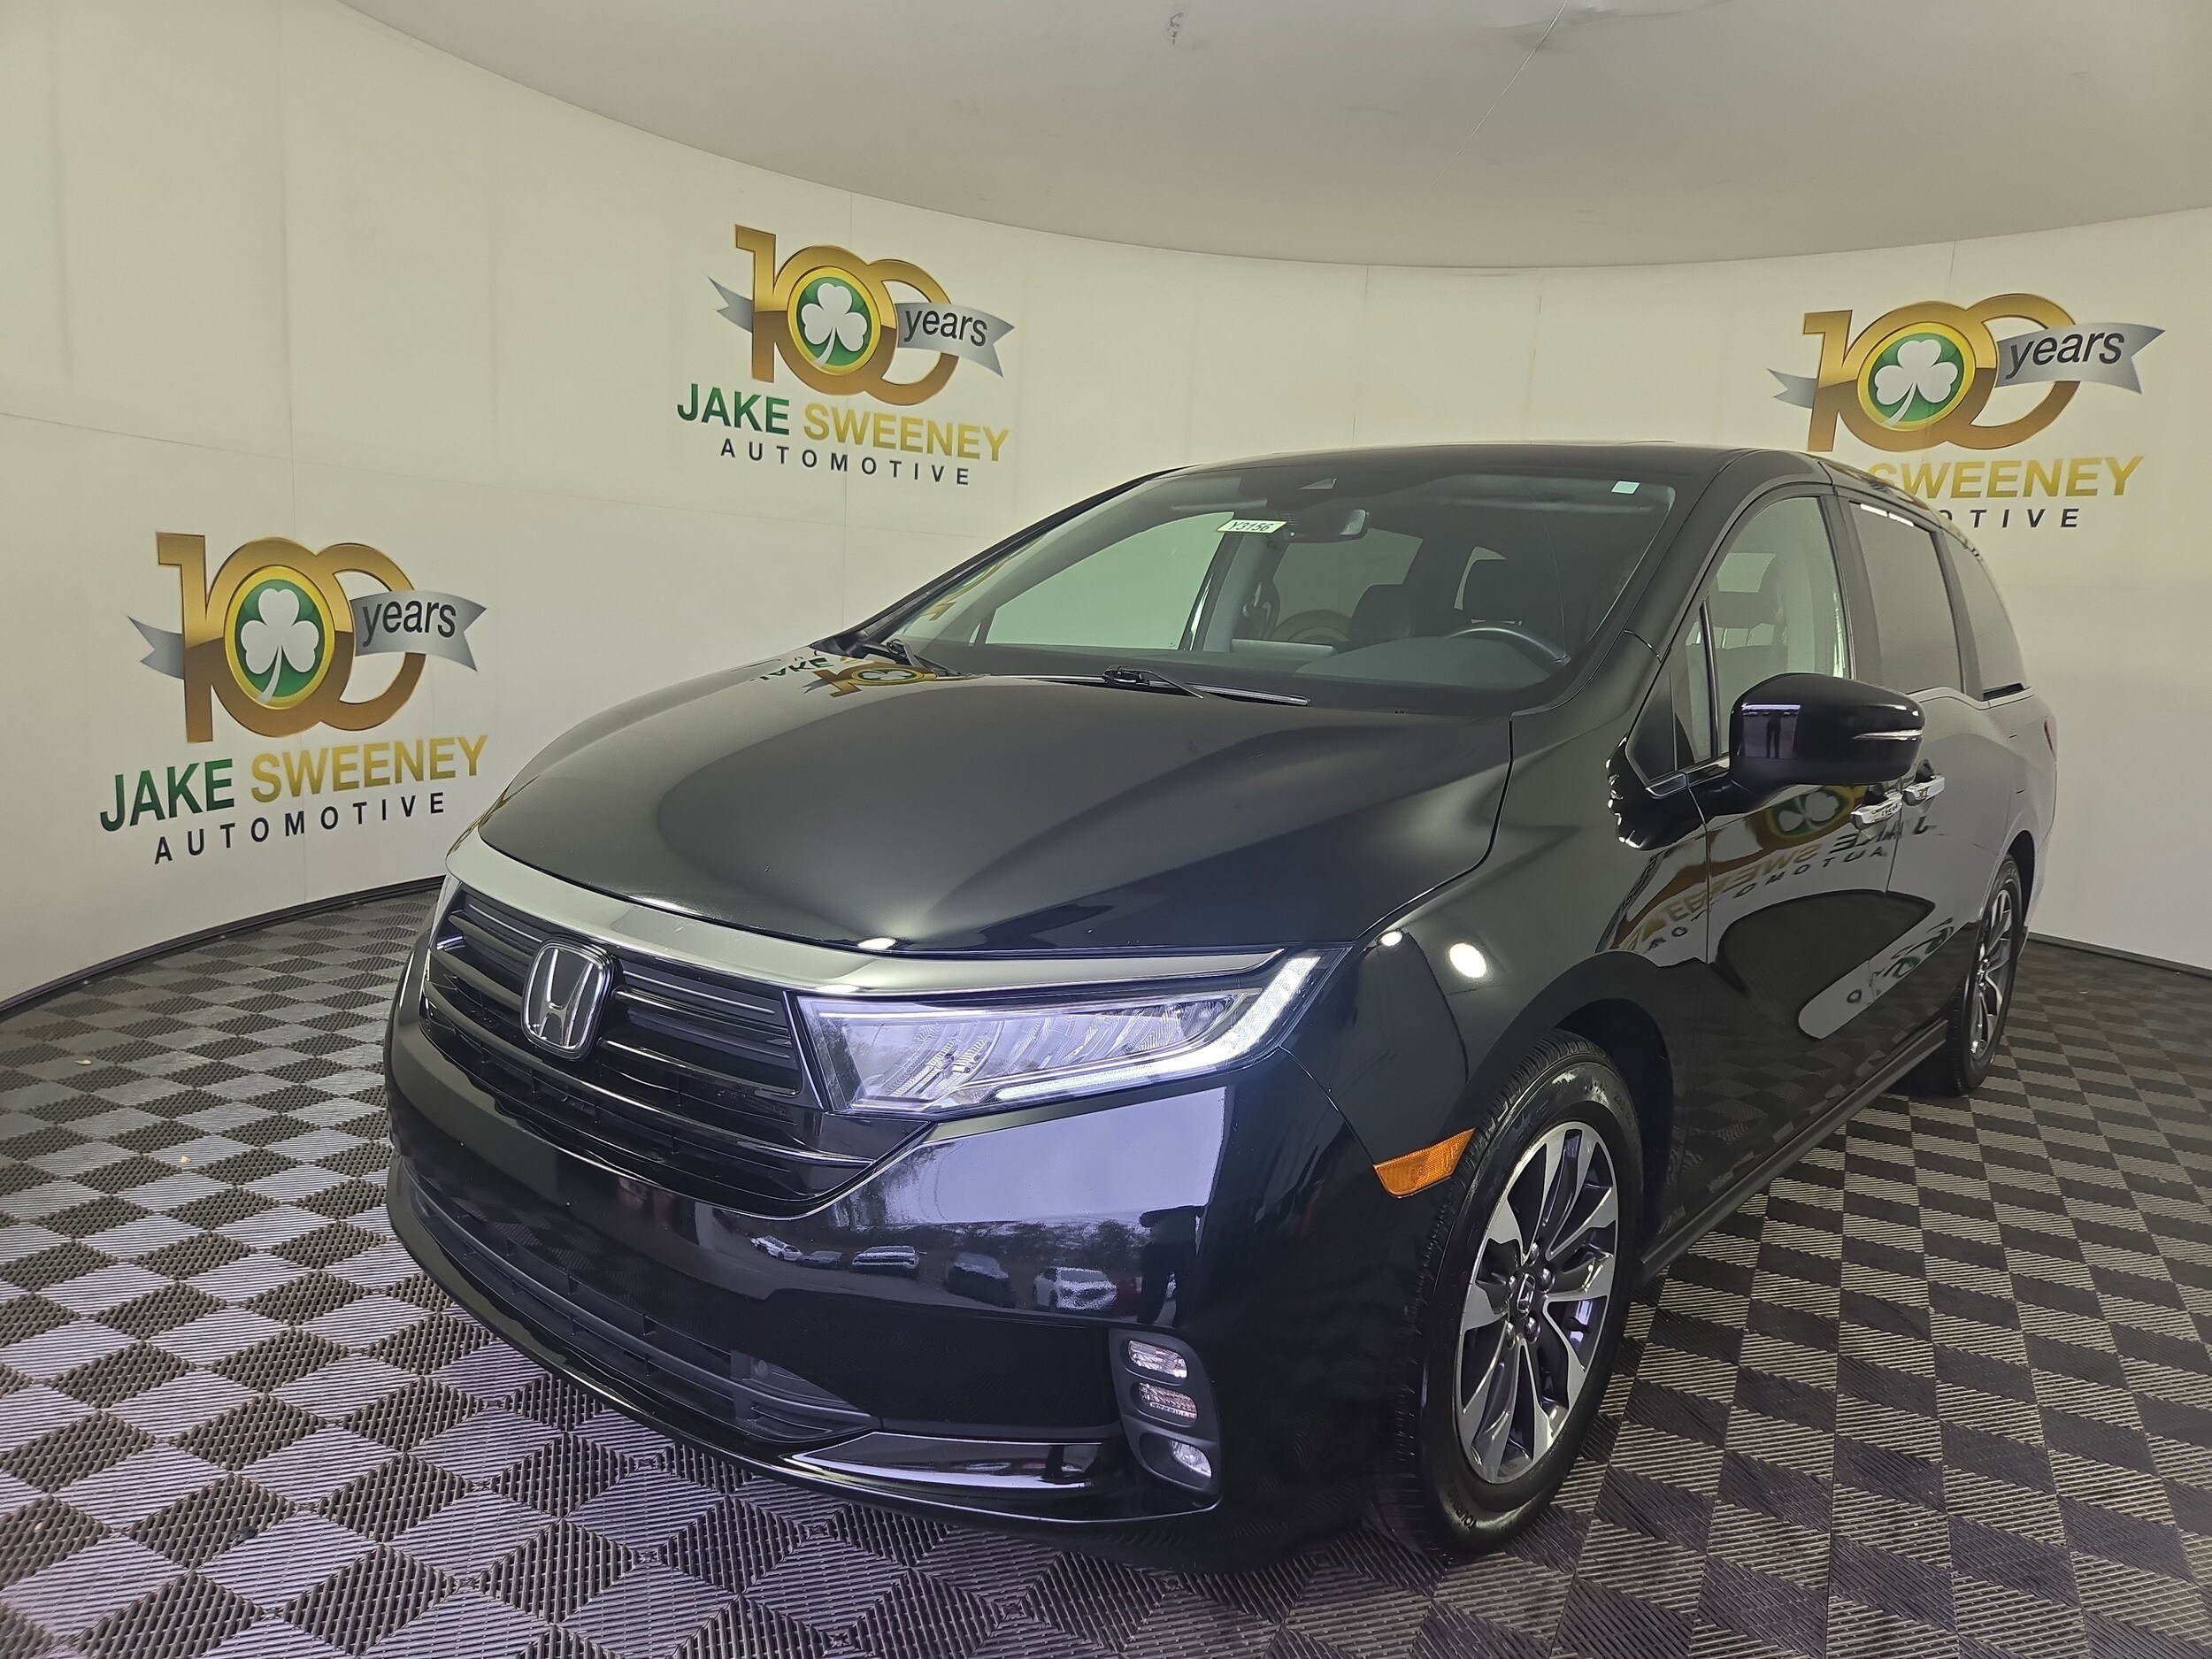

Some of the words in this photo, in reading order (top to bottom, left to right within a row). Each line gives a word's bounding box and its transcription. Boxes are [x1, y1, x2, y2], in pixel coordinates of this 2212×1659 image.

[903, 307, 988, 347] years
[2005, 332, 2125, 380] years
[677, 383, 790, 436] JAKE
[803, 403, 1010, 462] SWEENEY
[720, 438, 970, 485] AUTOMOTIVE
[1229, 521, 1273, 531] Y3156
[362, 599, 457, 647] years
[99, 758, 235, 833] JAKE
[250, 735, 488, 803] SWEENEY
[154, 792, 444, 865] AUTOMOTIVE
